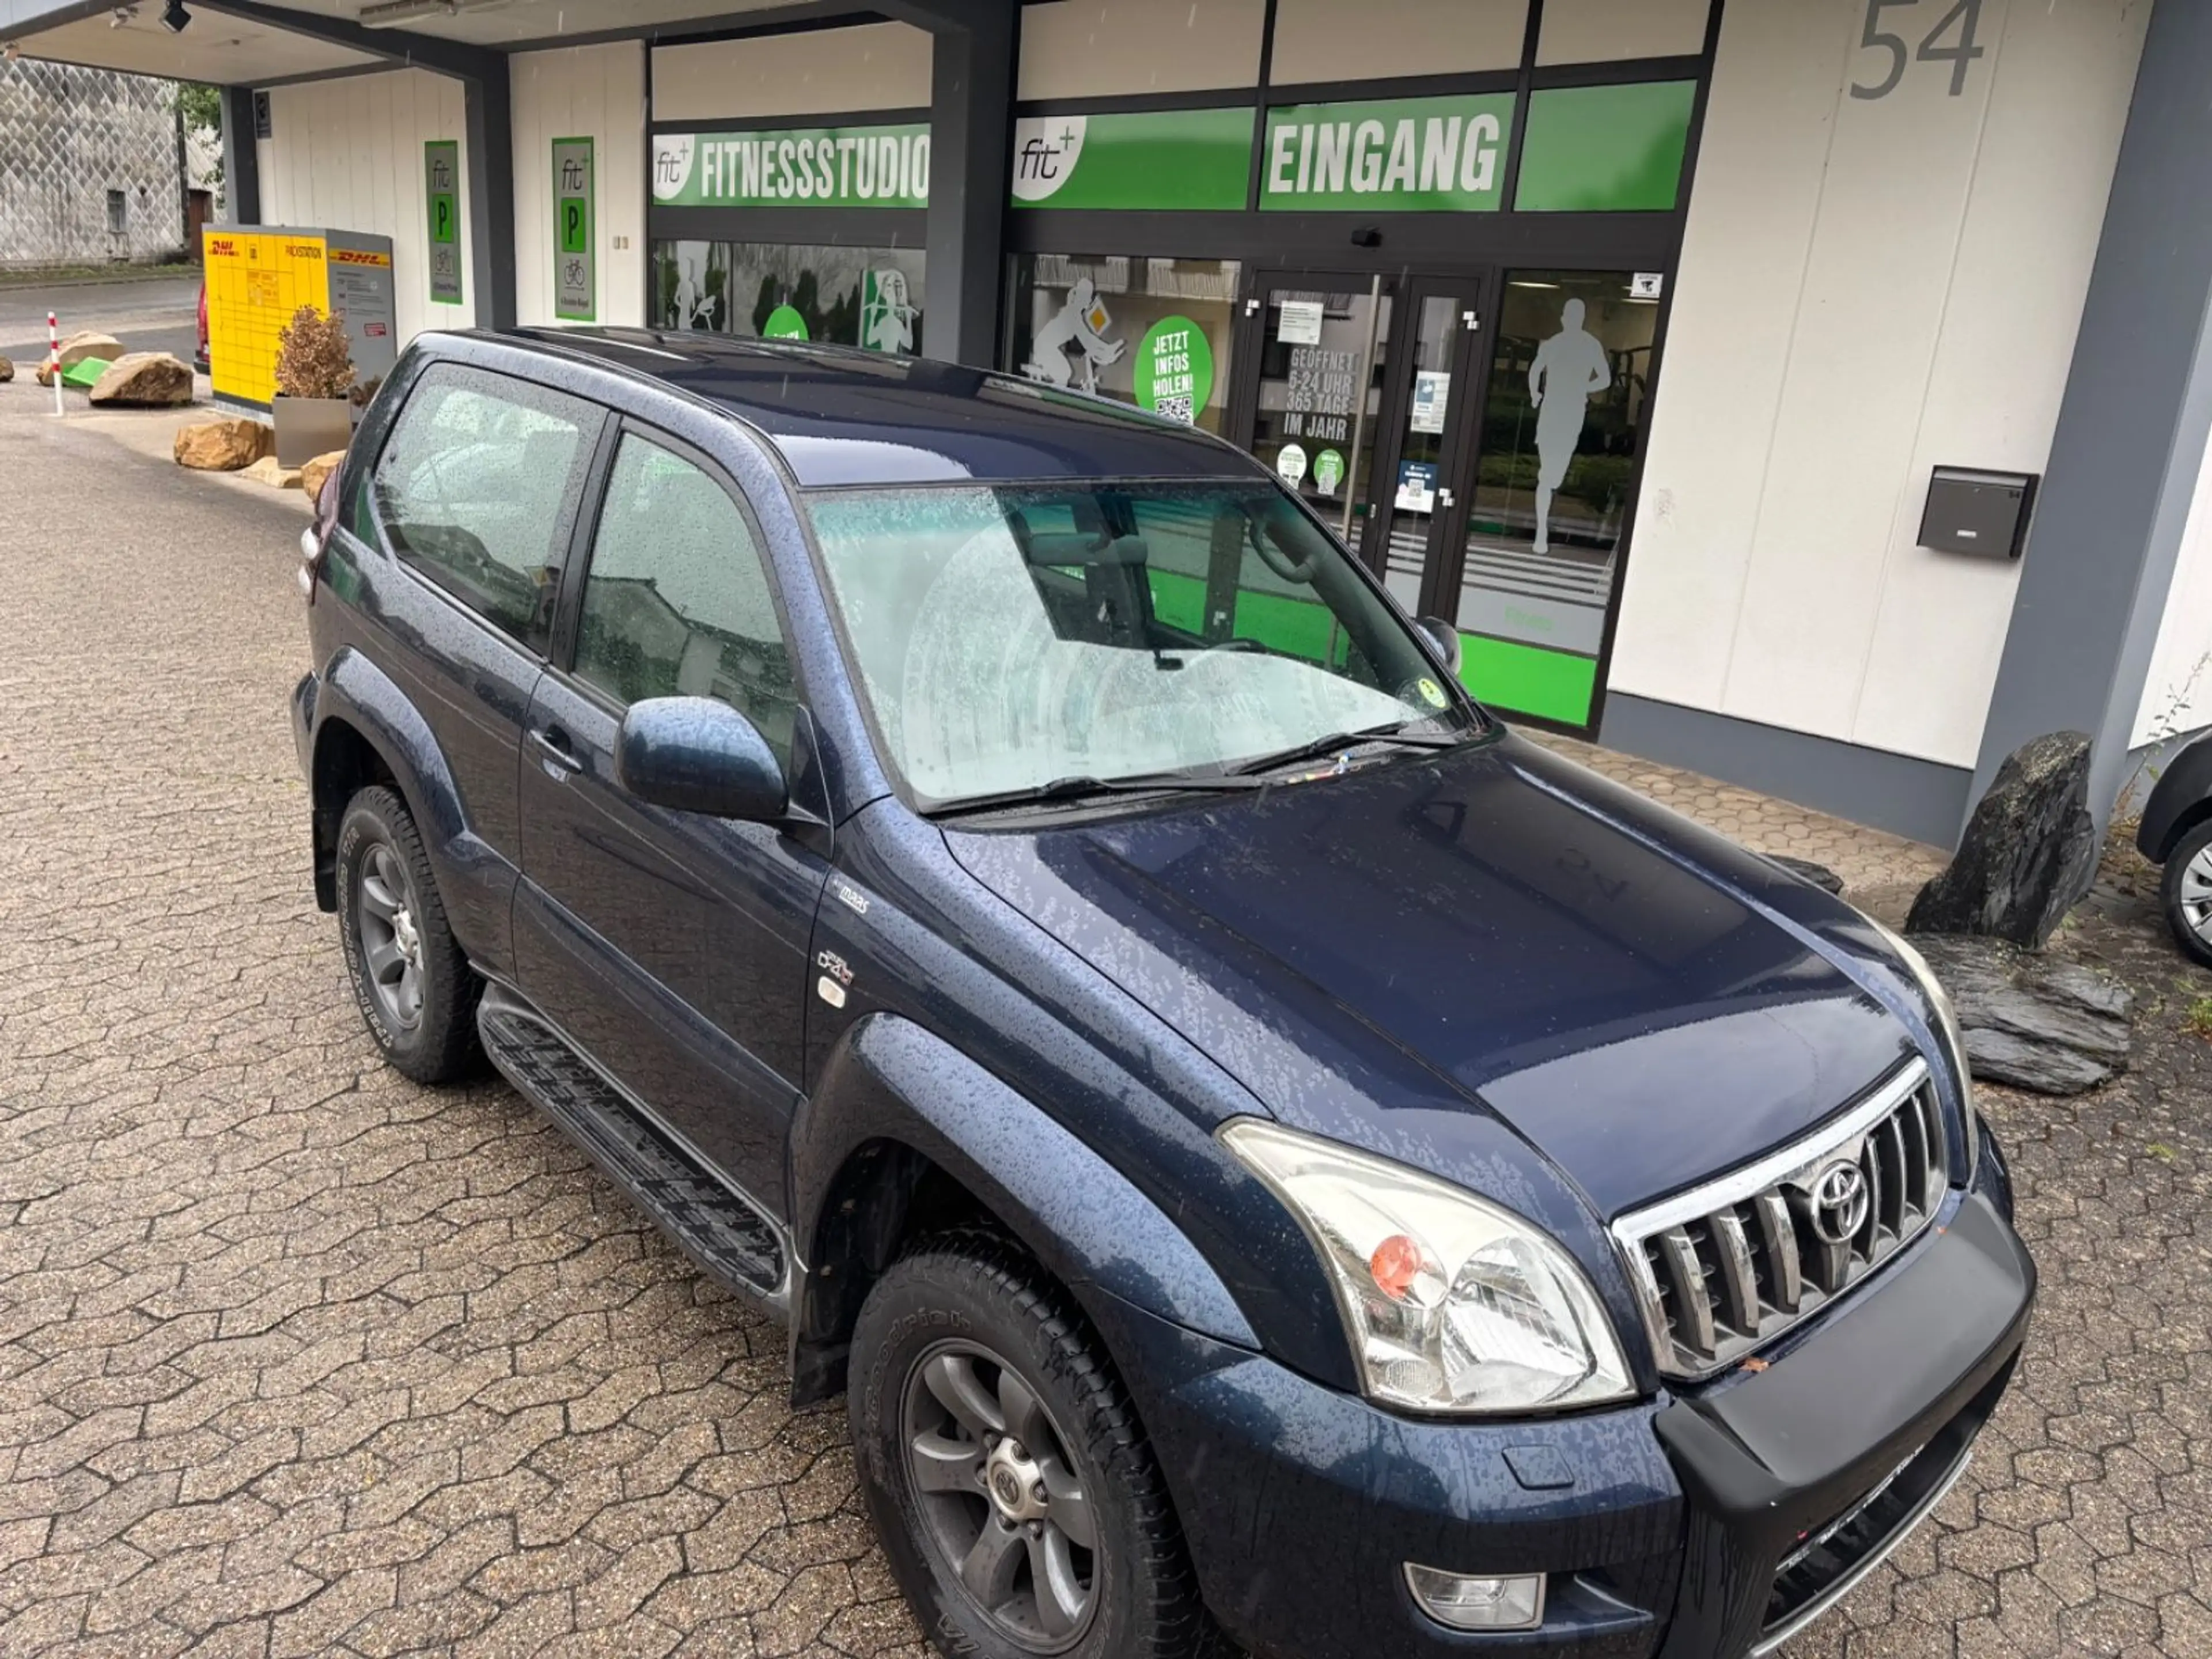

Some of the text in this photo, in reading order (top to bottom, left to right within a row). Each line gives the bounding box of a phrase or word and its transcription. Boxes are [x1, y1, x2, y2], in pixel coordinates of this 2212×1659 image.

[1850, 0, 1984, 100] 54
[1268, 113, 1499, 194] EINGANG
[700, 134, 931, 199] FITNESSSTUDIO
[438, 200, 448, 237] P
[567, 204, 579, 245] P
[211, 239, 235, 257] DHL
[285, 245, 323, 260] PACKSTATION
[337, 251, 381, 266] DHL
[1153, 330, 1190, 355] JETZT
[1155, 351, 1190, 376] INFOS
[1153, 373, 1194, 398] HOLEN!
[1288, 369, 1352, 395] 6-24 UHR
[1286, 391, 1350, 416] 365 TAGE
[1283, 412, 1348, 441] IM JAHR
